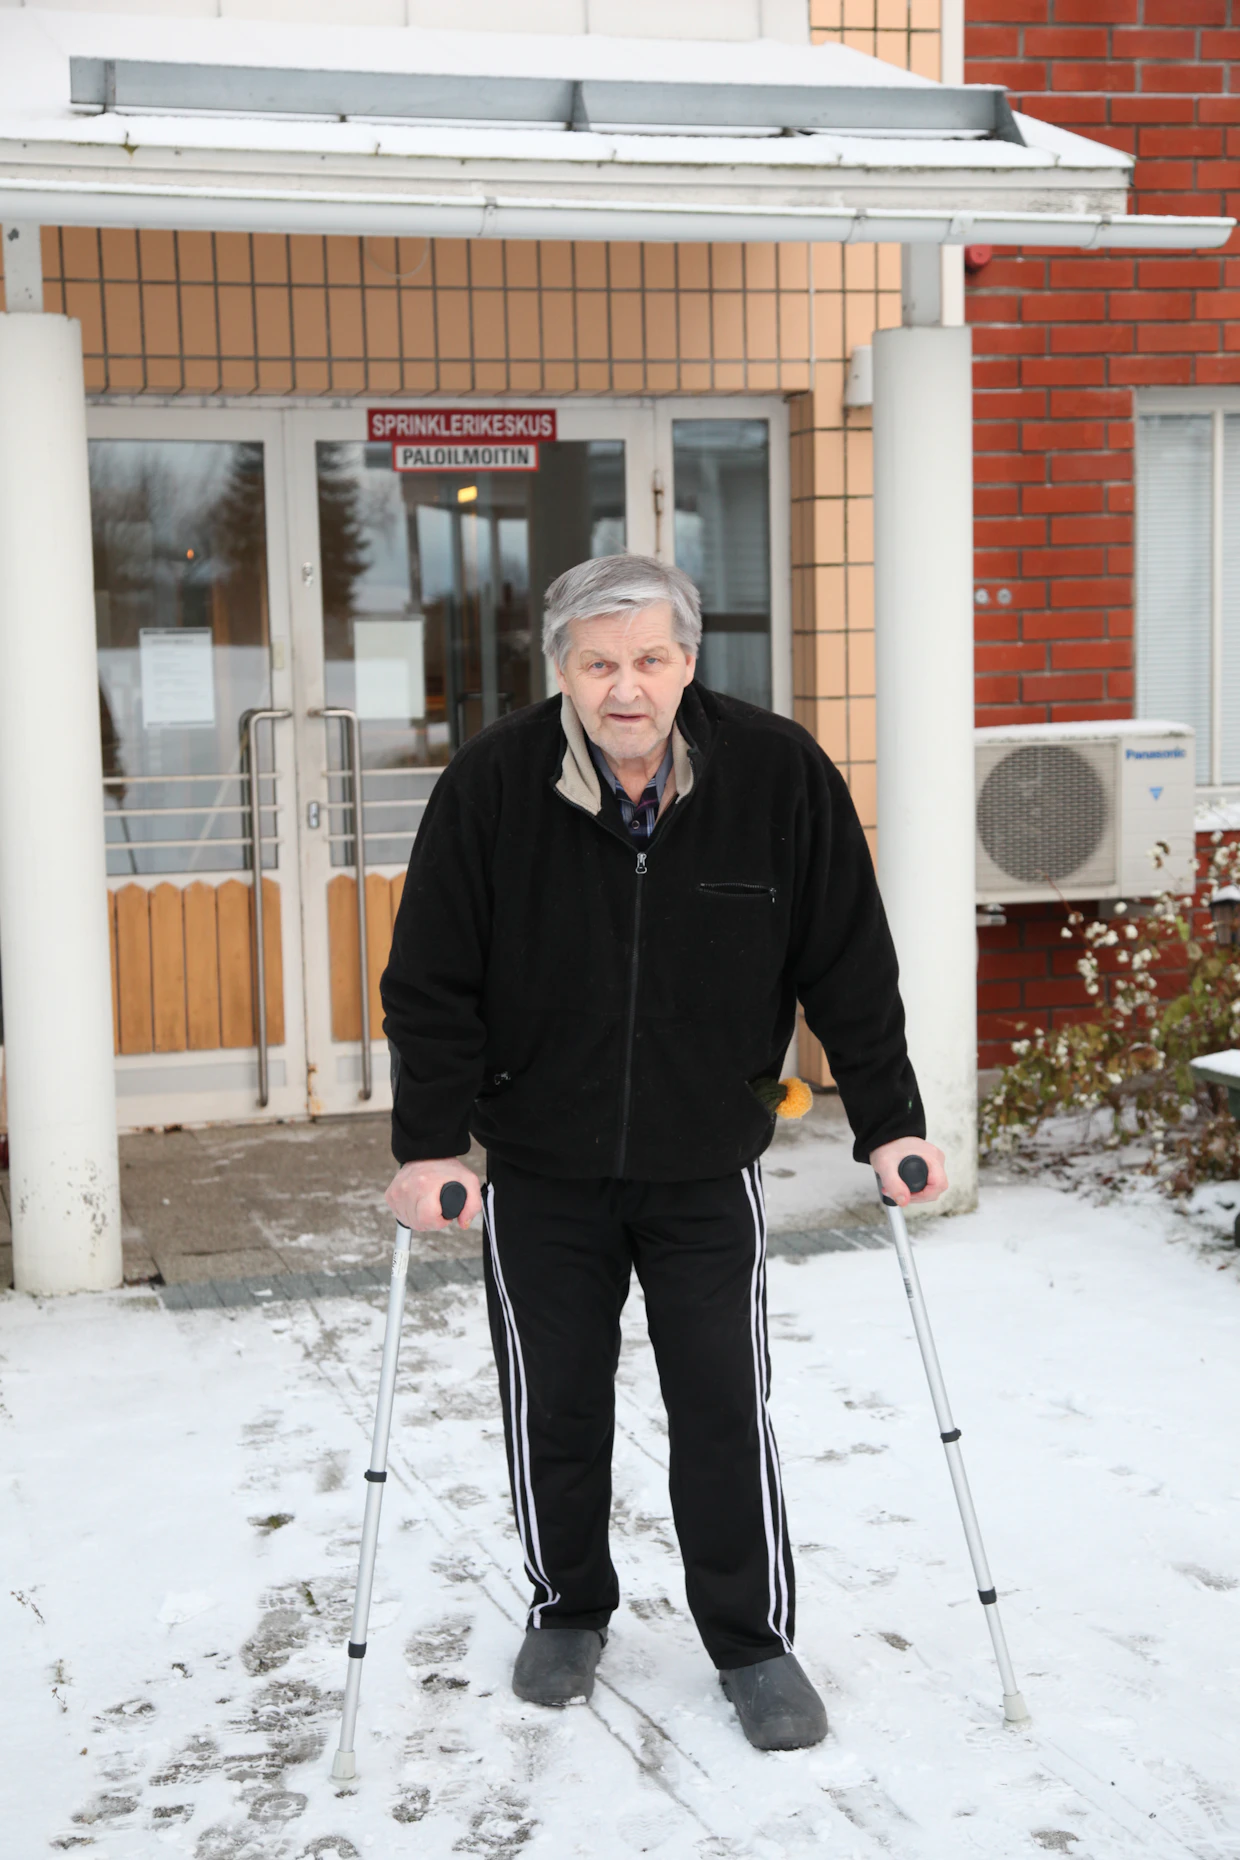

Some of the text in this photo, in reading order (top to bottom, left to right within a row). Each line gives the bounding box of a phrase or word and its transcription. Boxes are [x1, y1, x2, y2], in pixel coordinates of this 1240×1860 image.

[372, 413, 553, 436] SPRINKLERIKESKUS
[402, 447, 530, 465] PALOILMOITIN
[1126, 747, 1186, 759] Panasonic
